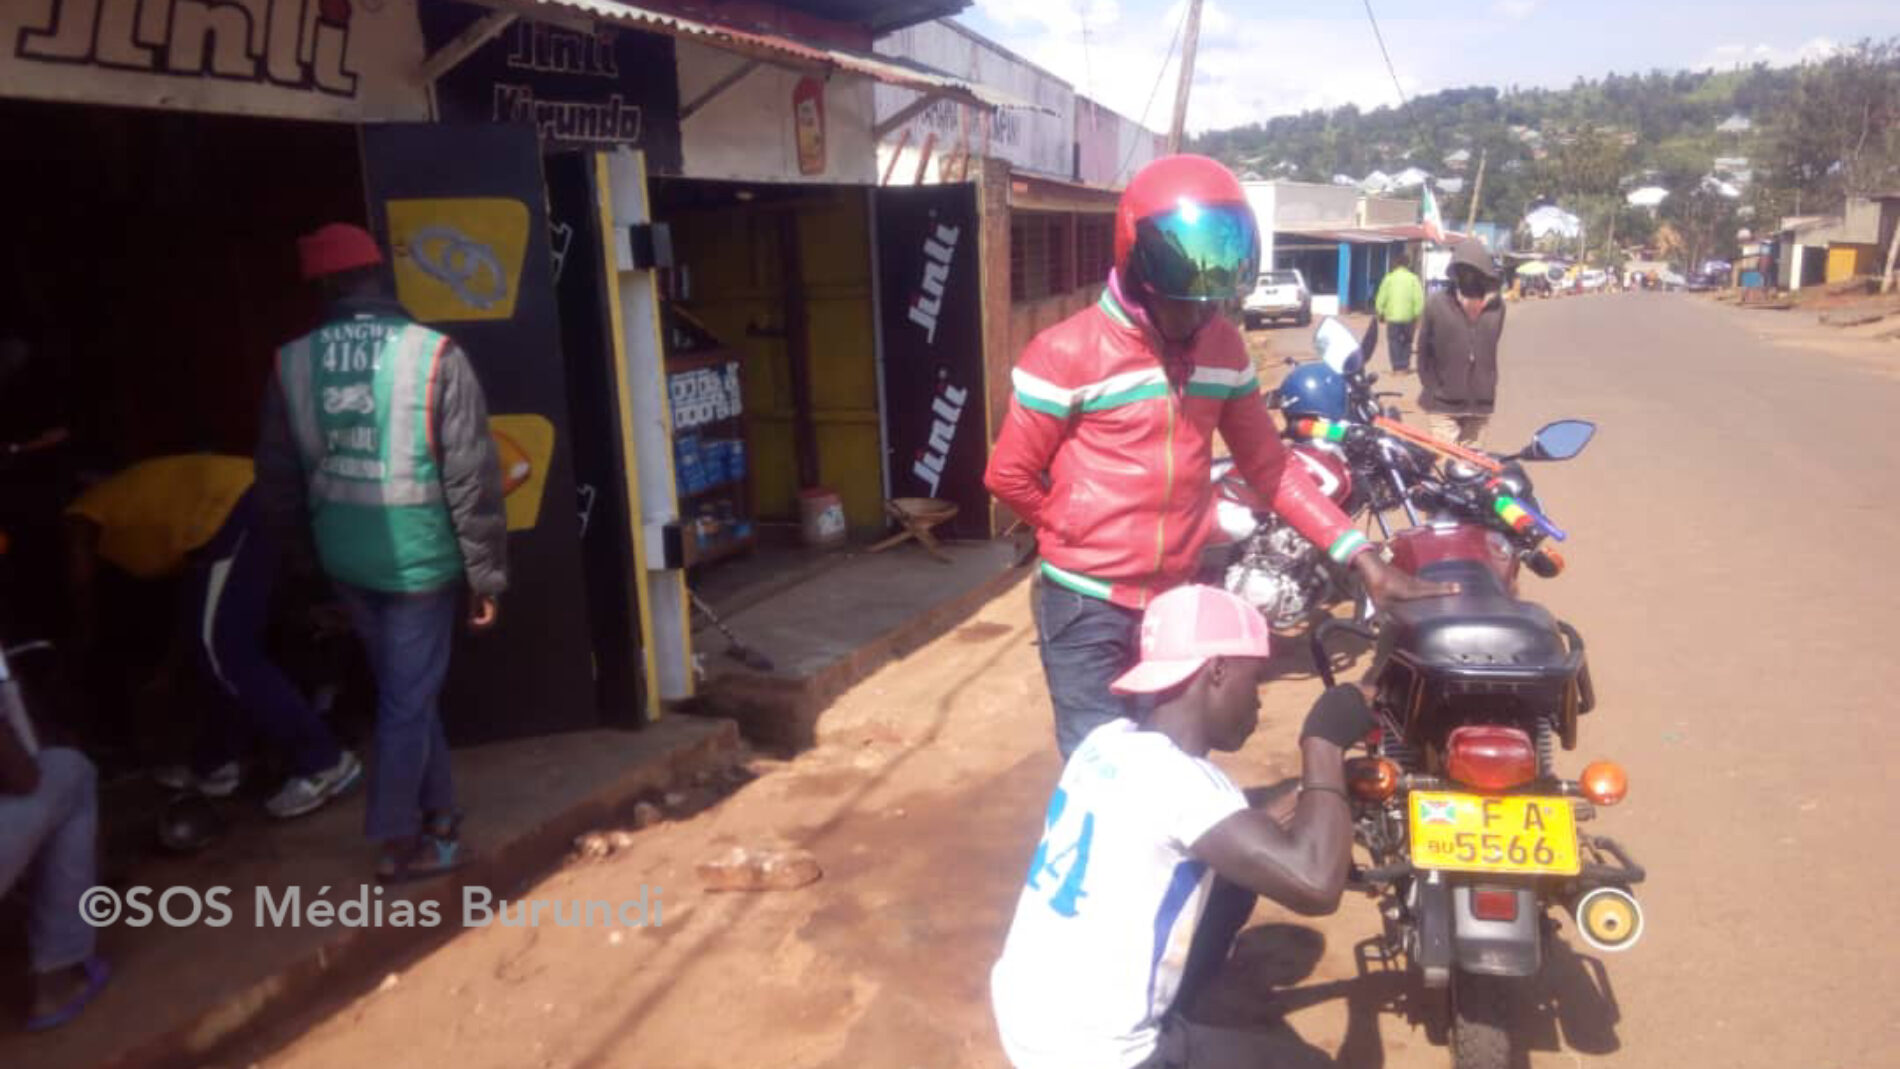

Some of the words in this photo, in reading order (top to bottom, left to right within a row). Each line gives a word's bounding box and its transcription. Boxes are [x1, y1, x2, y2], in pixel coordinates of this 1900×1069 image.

[908, 223, 960, 343] Jinli
[323, 341, 383, 372] 4161
[913, 384, 968, 498] Jinli
[1482, 800, 1503, 828] F
[1523, 803, 1545, 831] A
[1455, 832, 1555, 865] 5566
